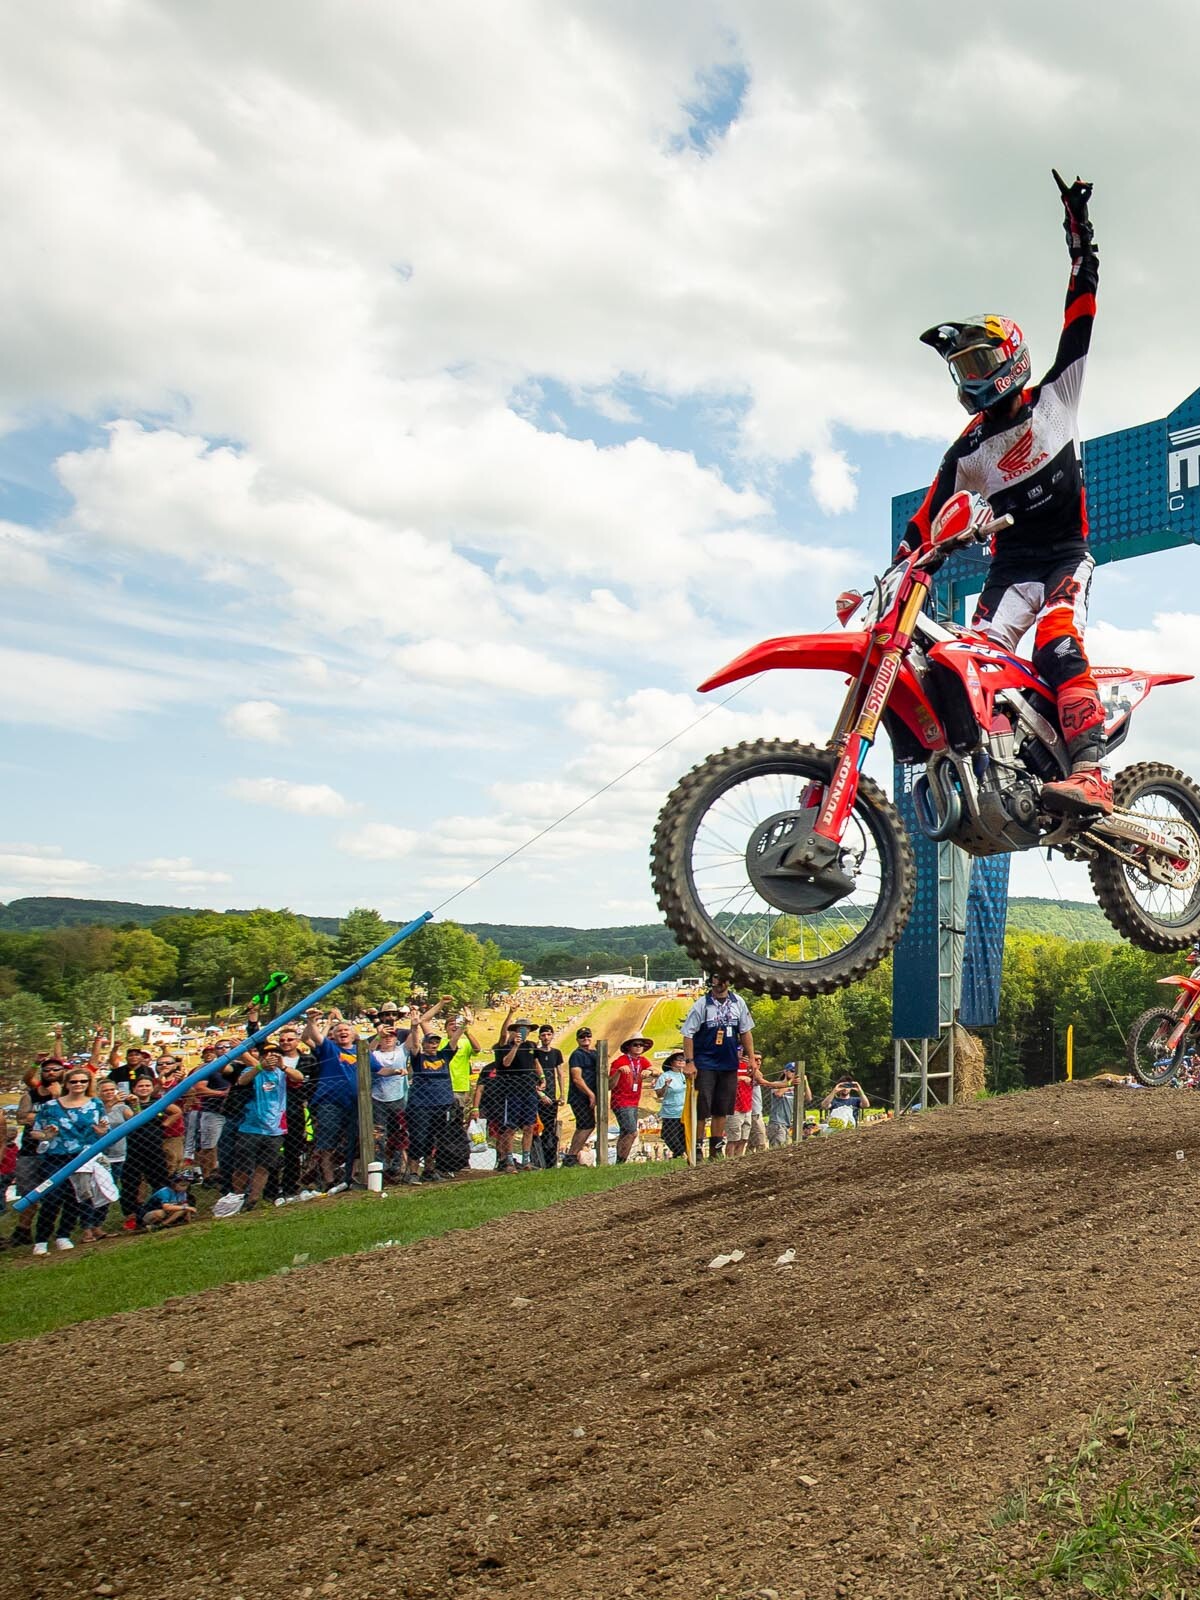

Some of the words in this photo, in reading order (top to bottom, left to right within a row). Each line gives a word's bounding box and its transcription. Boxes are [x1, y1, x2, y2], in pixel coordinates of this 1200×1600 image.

[1002, 452, 1048, 482] HONDA
[867, 657, 896, 713] SHOWA
[822, 755, 852, 826] DUNLOP
